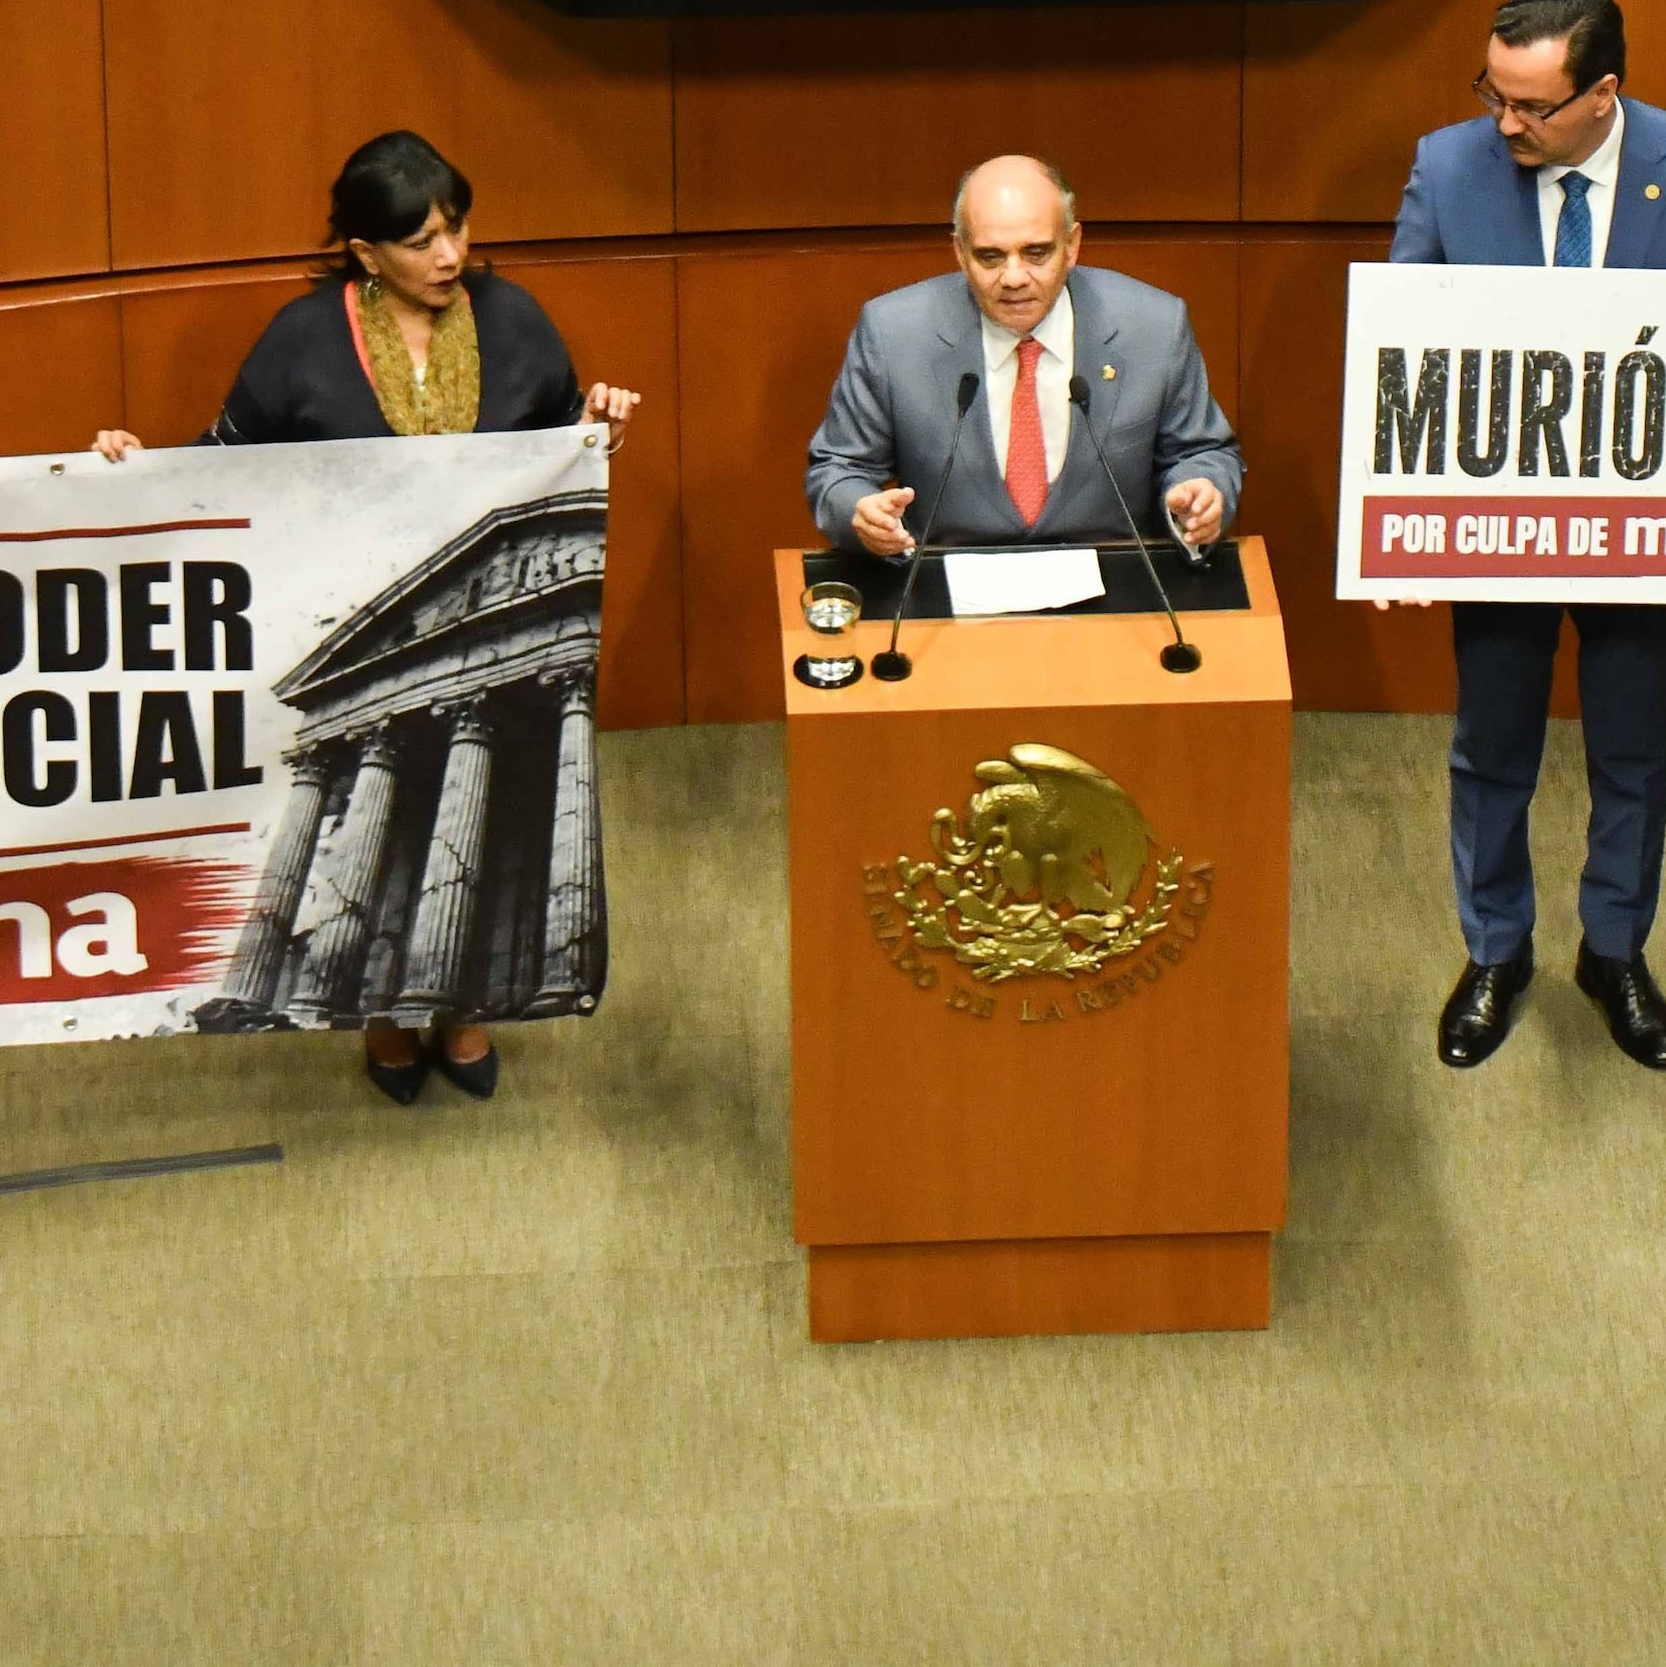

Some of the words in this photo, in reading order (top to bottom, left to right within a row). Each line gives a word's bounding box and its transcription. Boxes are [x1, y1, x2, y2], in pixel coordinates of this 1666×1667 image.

[1381, 513, 1446, 555] POR
[1455, 514, 1558, 556] CULPA
[1567, 517, 1610, 557] DE
[1019, 997, 1068, 1023] LA
